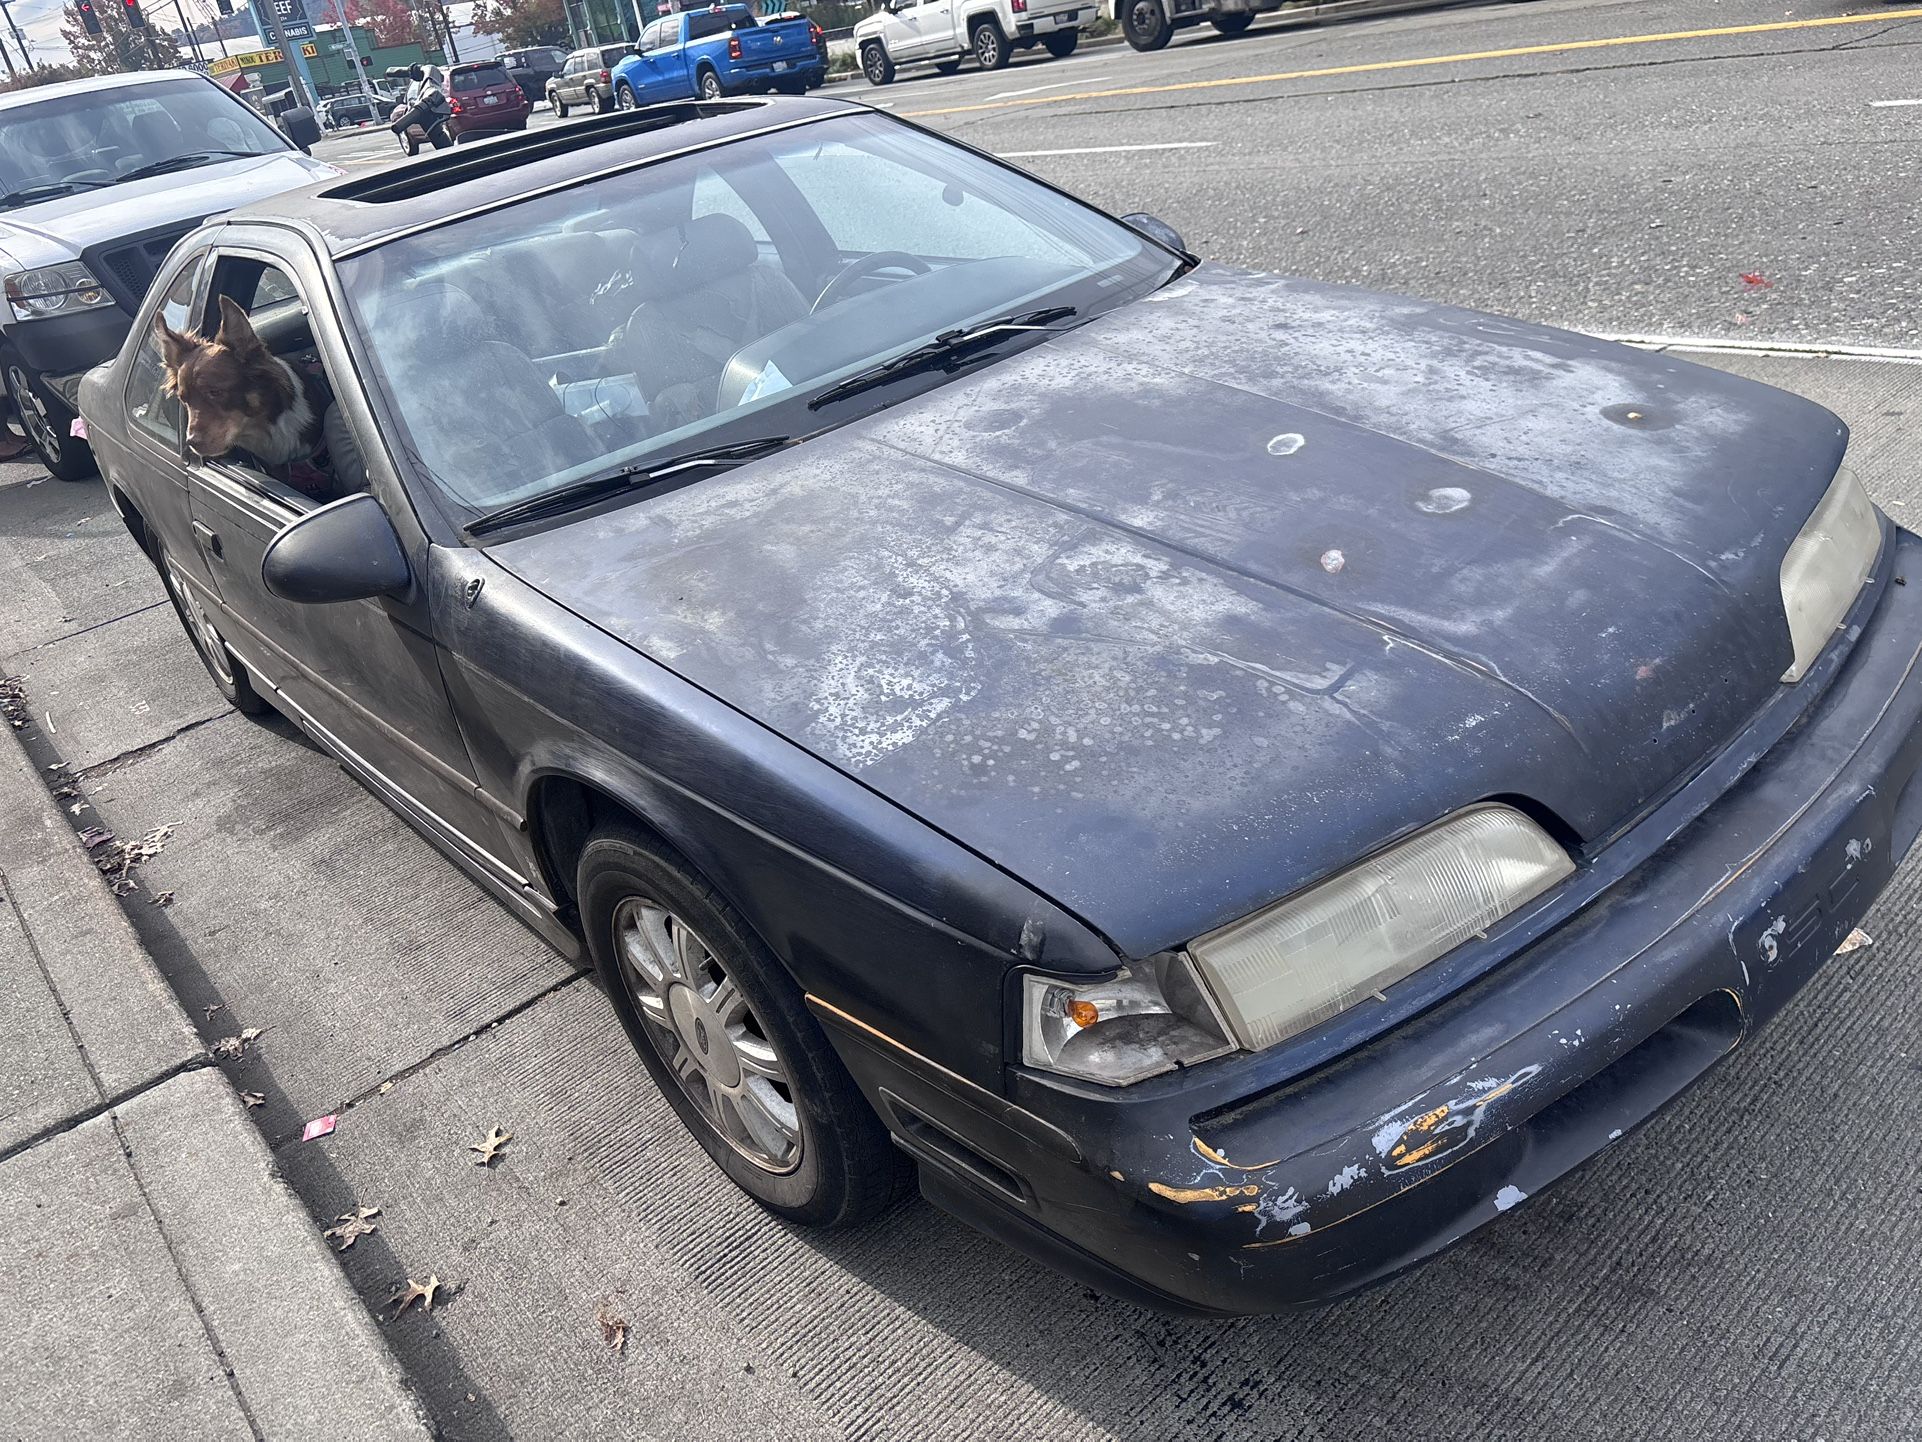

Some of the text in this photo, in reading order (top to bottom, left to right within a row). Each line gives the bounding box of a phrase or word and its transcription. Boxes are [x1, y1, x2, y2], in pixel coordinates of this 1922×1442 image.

[273, 0, 292, 15] EEF
[269, 26, 308, 40] CNABIS
[257, 46, 315, 63] TERKI
